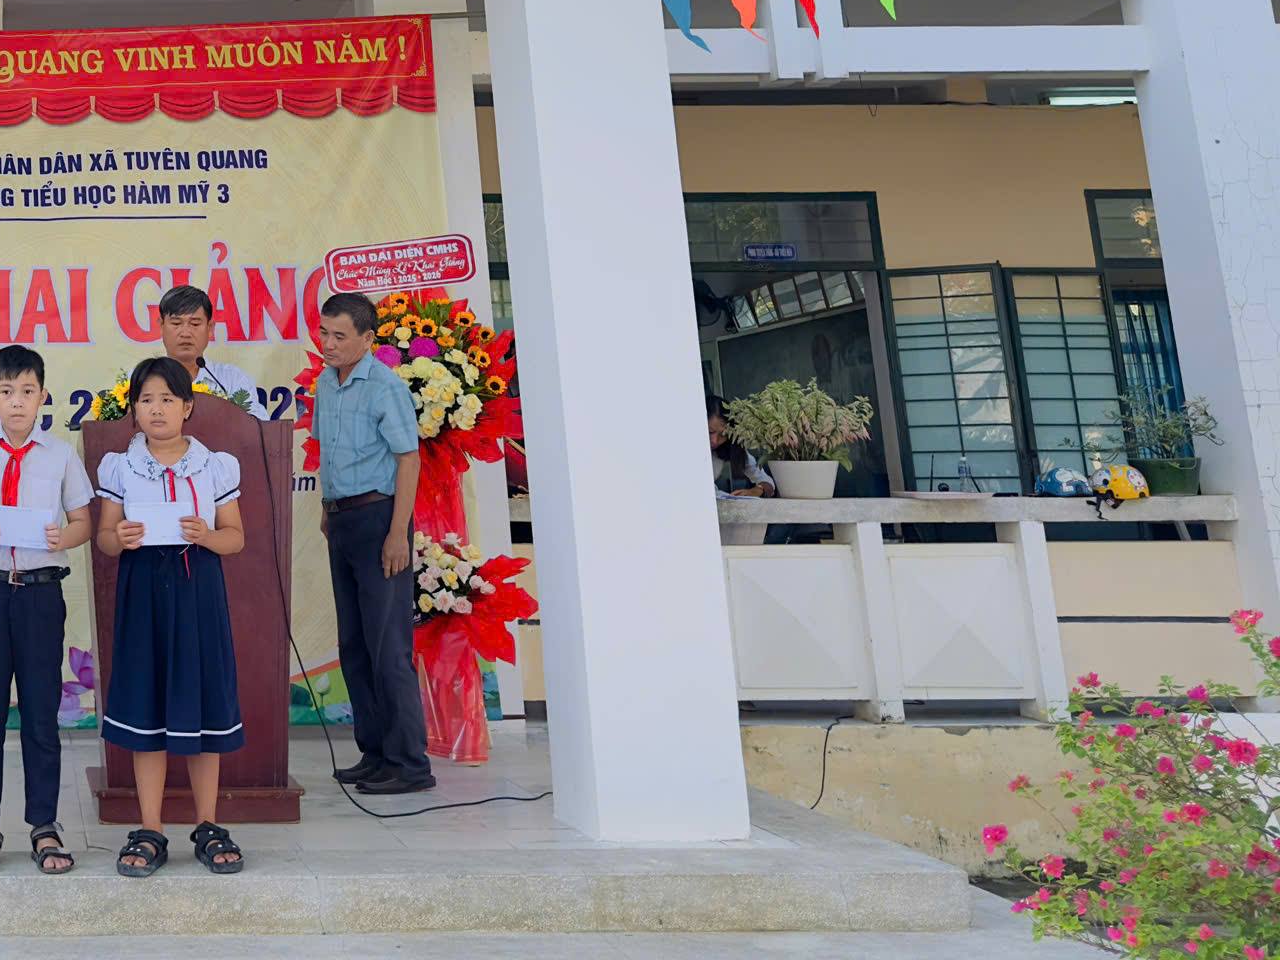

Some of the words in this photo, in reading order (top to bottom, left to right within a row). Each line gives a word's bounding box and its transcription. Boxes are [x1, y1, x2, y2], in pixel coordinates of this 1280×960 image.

[113, 45, 195, 71] VINH
[205, 36, 303, 68] MUÔN
[314, 33, 388, 64] NĂM
[39, 151, 83, 175] DÂN
[89, 149, 118, 172] XÃ
[123, 147, 191, 171] TUYÊN
[197, 148, 268, 172] QUANG
[21, 180, 67, 207] TIỂU
[73, 184, 116, 209] HỌC
[122, 180, 171, 205] HÀM
[177, 180, 210, 204] MỸ
[217, 183, 230, 204] 3
[340, 254, 367, 266] BAN
[369, 250, 392, 262] ĐẠI
[395, 246, 424, 259] DIỆN
[426, 242, 459, 256] CMHS
[399, 274, 417, 283] 2025
[422, 270, 442, 280] 2026
